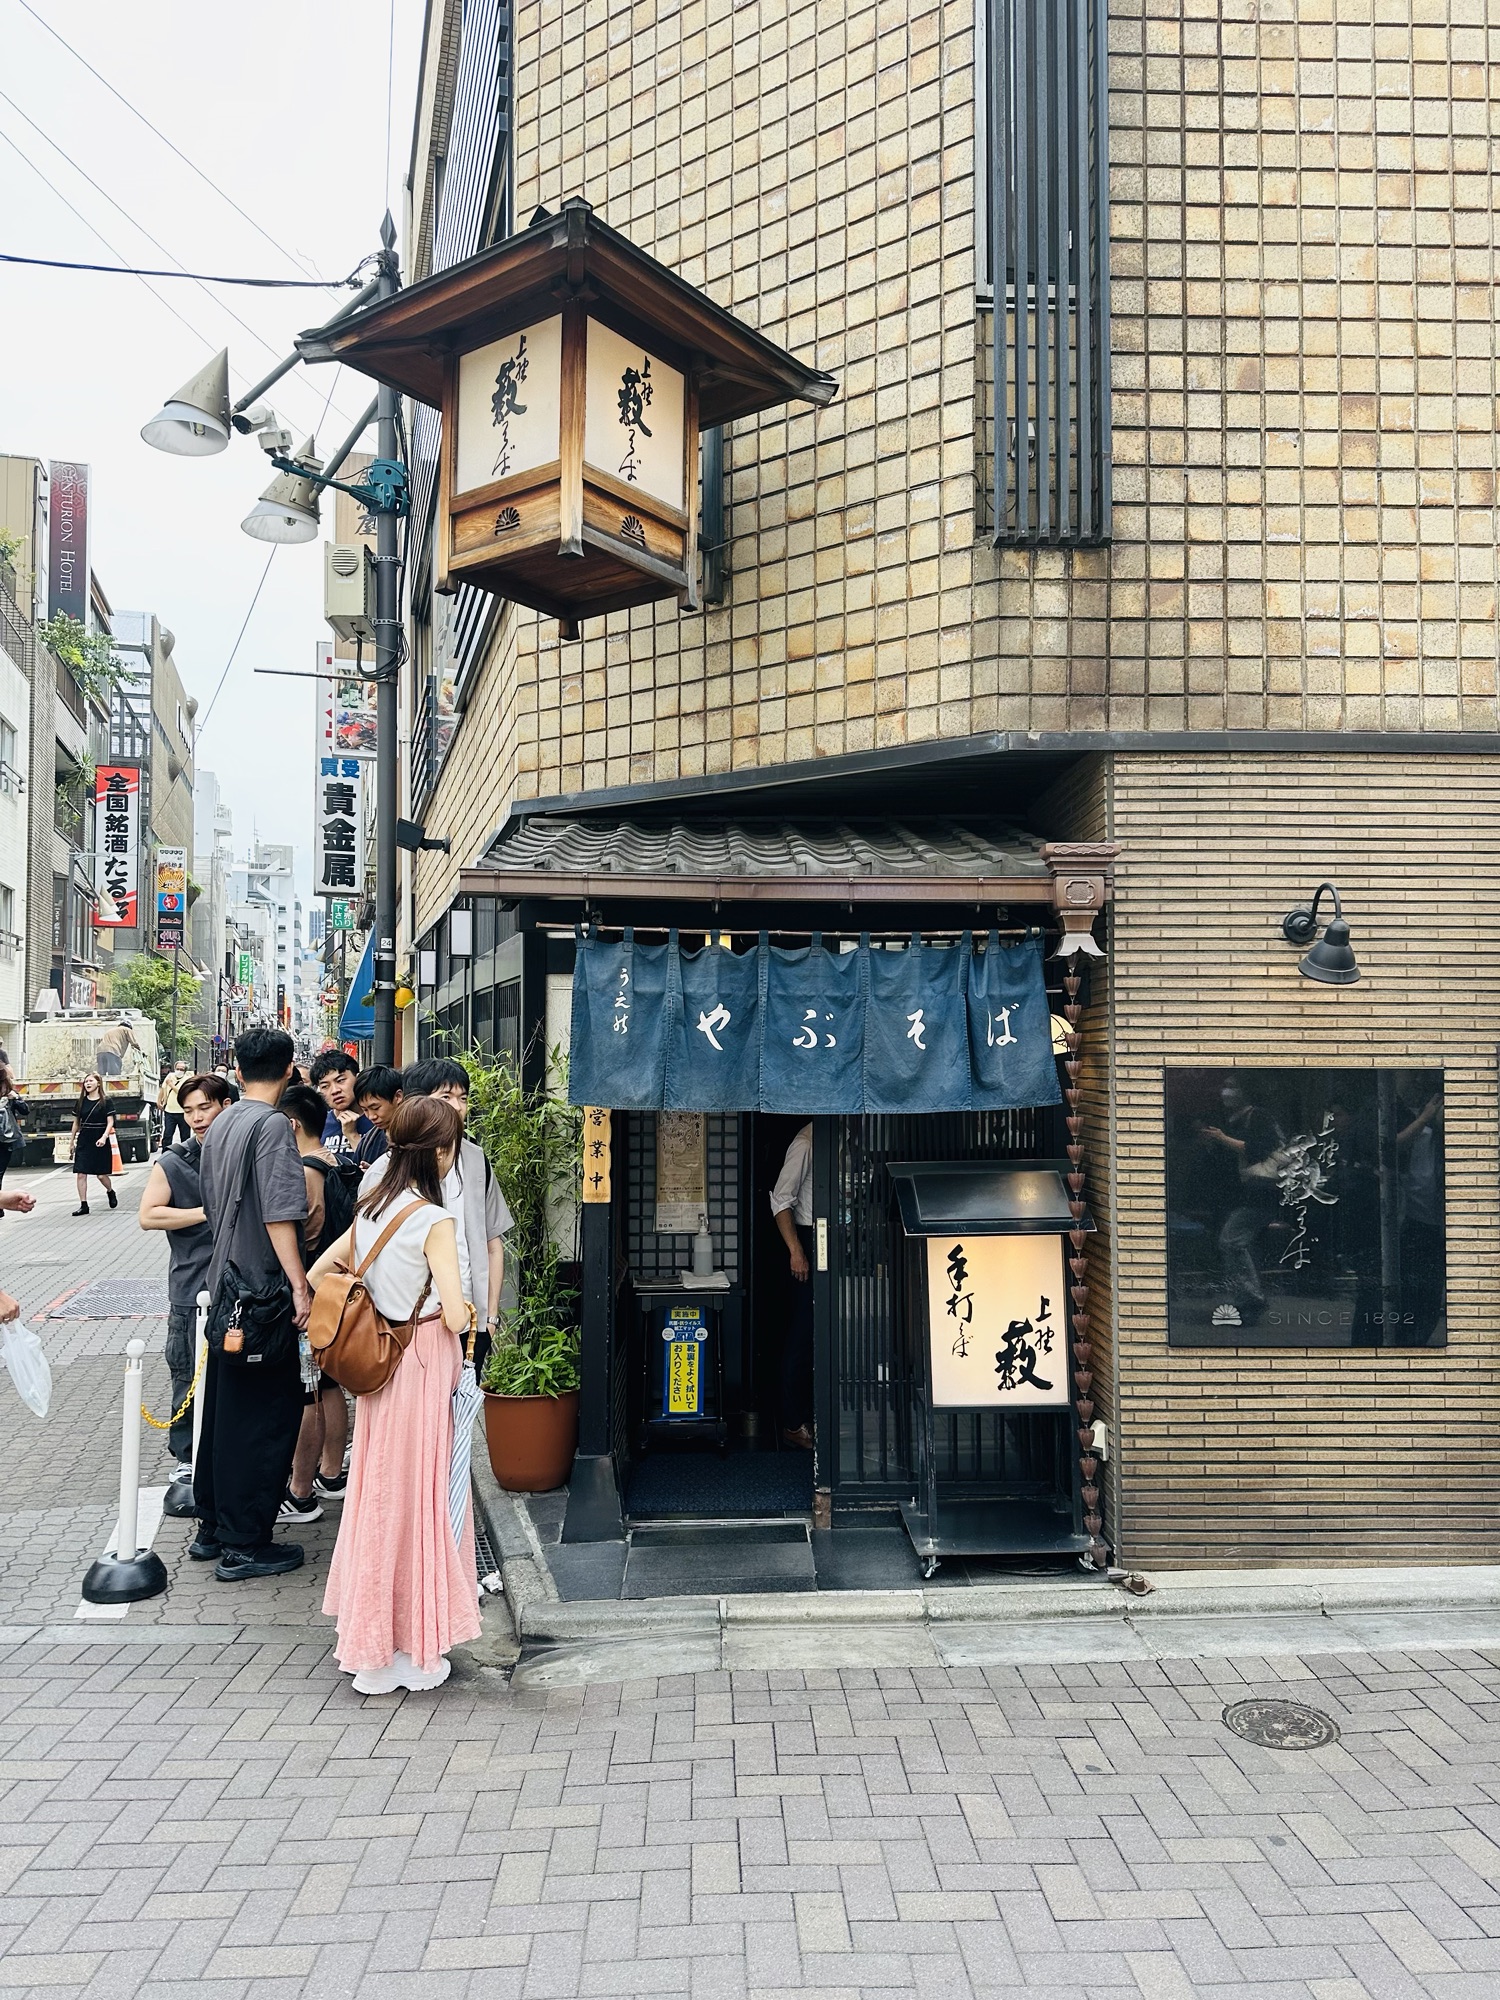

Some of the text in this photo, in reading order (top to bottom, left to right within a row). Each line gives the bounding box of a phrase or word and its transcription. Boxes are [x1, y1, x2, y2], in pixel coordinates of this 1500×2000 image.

[59, 464, 77, 594] CENTURION HOTEL
[321, 782, 357, 888] 貴金属
[381, 939, 391, 948] 24
[696, 1002, 1020, 1051] やぶそば
[588, 1108, 607, 1191] 営業中
[674, 1310, 697, 1318] 実施中
[1268, 1310, 1415, 1326] SINCE 1892
[672, 1344, 683, 1403] お入りください
[685, 1344, 696, 1410] 靴裏をよく拭いて
